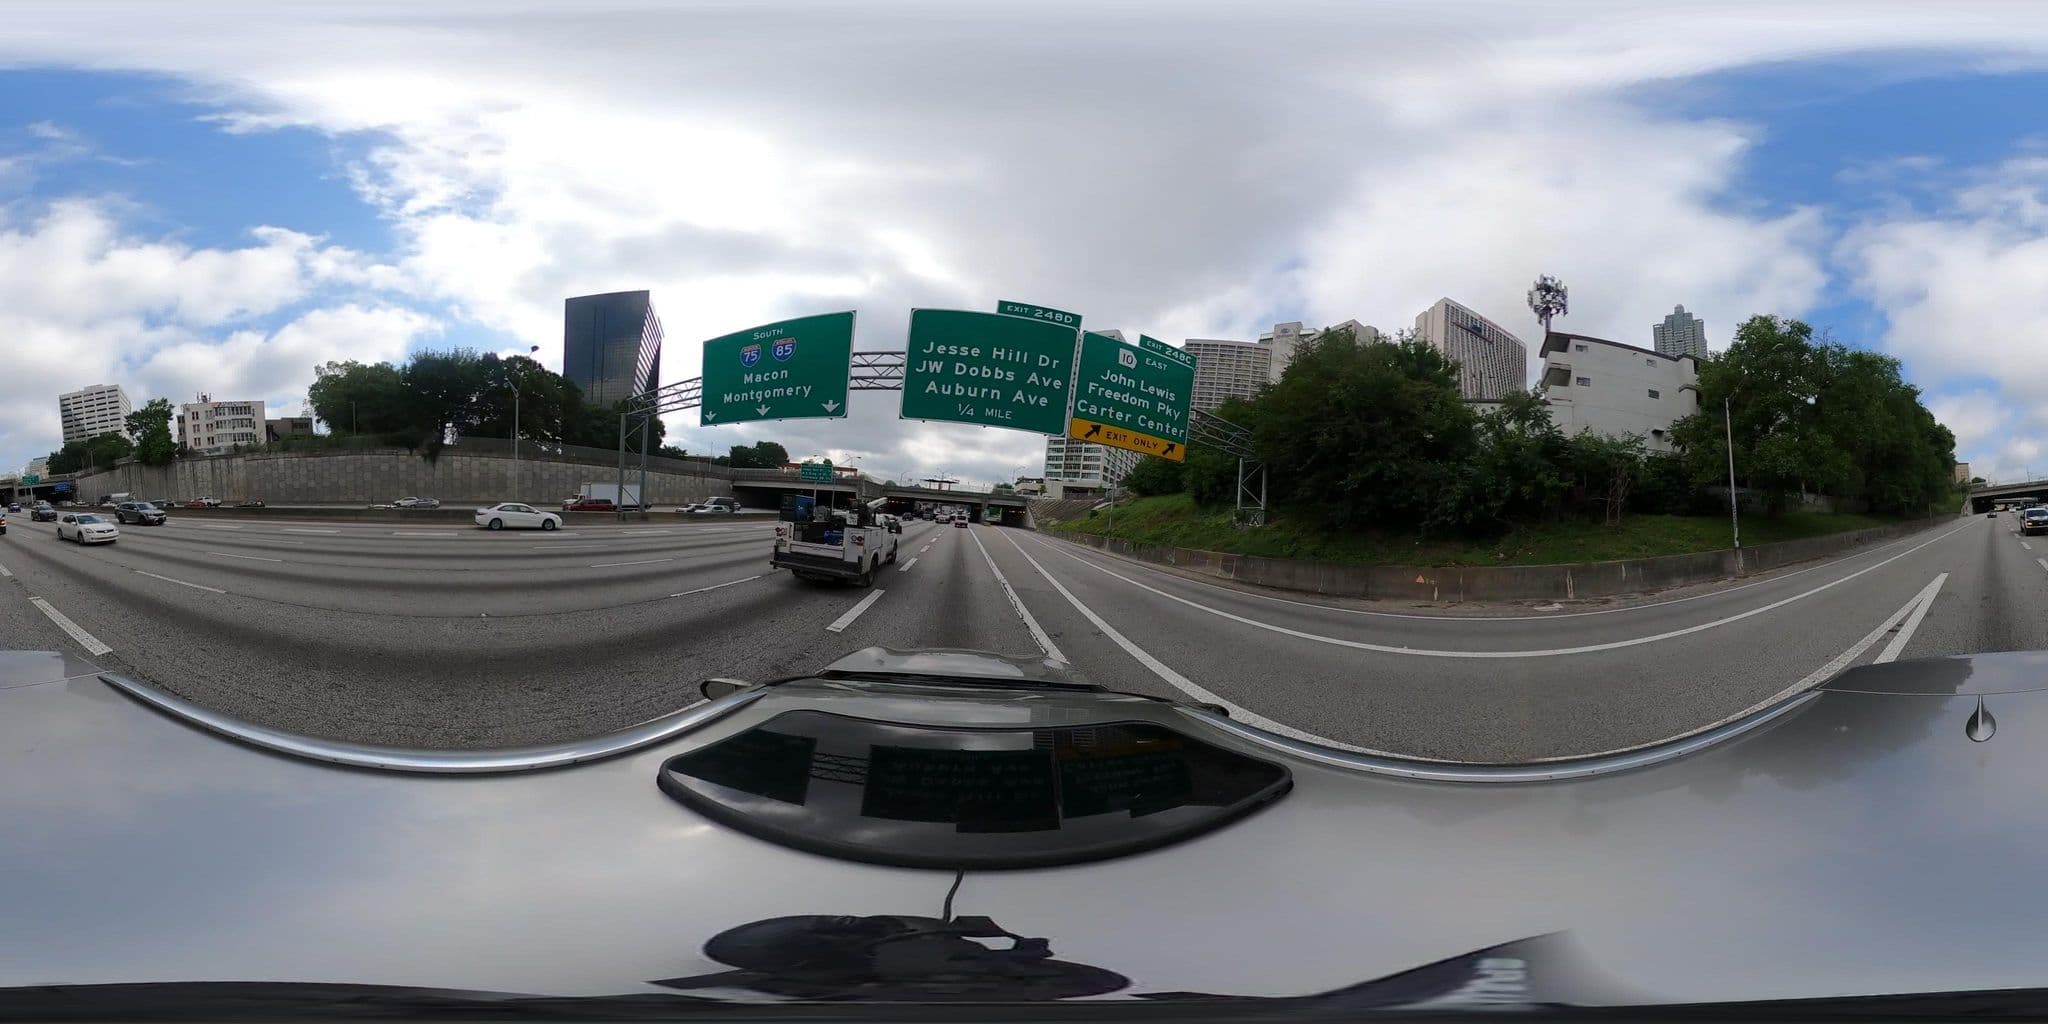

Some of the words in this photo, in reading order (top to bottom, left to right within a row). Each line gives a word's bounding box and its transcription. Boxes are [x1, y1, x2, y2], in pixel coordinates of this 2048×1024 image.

[1006, 305, 1029, 313] EXIT
[1033, 309, 1073, 324] 248D
[753, 328, 783, 340] SOUTH
[744, 350, 758, 362] 75
[775, 344, 793, 356] 85
[922, 342, 981, 357] Jesse
[992, 347, 1028, 363] Hill
[1038, 354, 1060, 369] Dr
[1123, 353, 1133, 364] 10
[1146, 340, 1162, 350] EXIT
[1165, 348, 1192, 364] 248C
[1145, 358, 1167, 371] EAST
[744, 370, 788, 384] Macon
[915, 360, 944, 373] JW
[954, 362, 1015, 381] Dobbs
[1026, 372, 1062, 390] Ave
[724, 385, 812, 404] Montgomery
[925, 381, 1000, 400] Auburn
[1012, 390, 1048, 407] Ave
[1100, 370, 1135, 388] John
[1140, 380, 1176, 401] Lewis
[1088, 382, 1150, 409] Freedom
[1157, 402, 1181, 420] Pky
[985, 408, 1012, 419] MILE
[1077, 400, 1132, 422] Carter
[1138, 415, 1184, 438] Center
[1106, 431, 1127, 441] EXIT
[1134, 438, 1158, 449] ONLY
